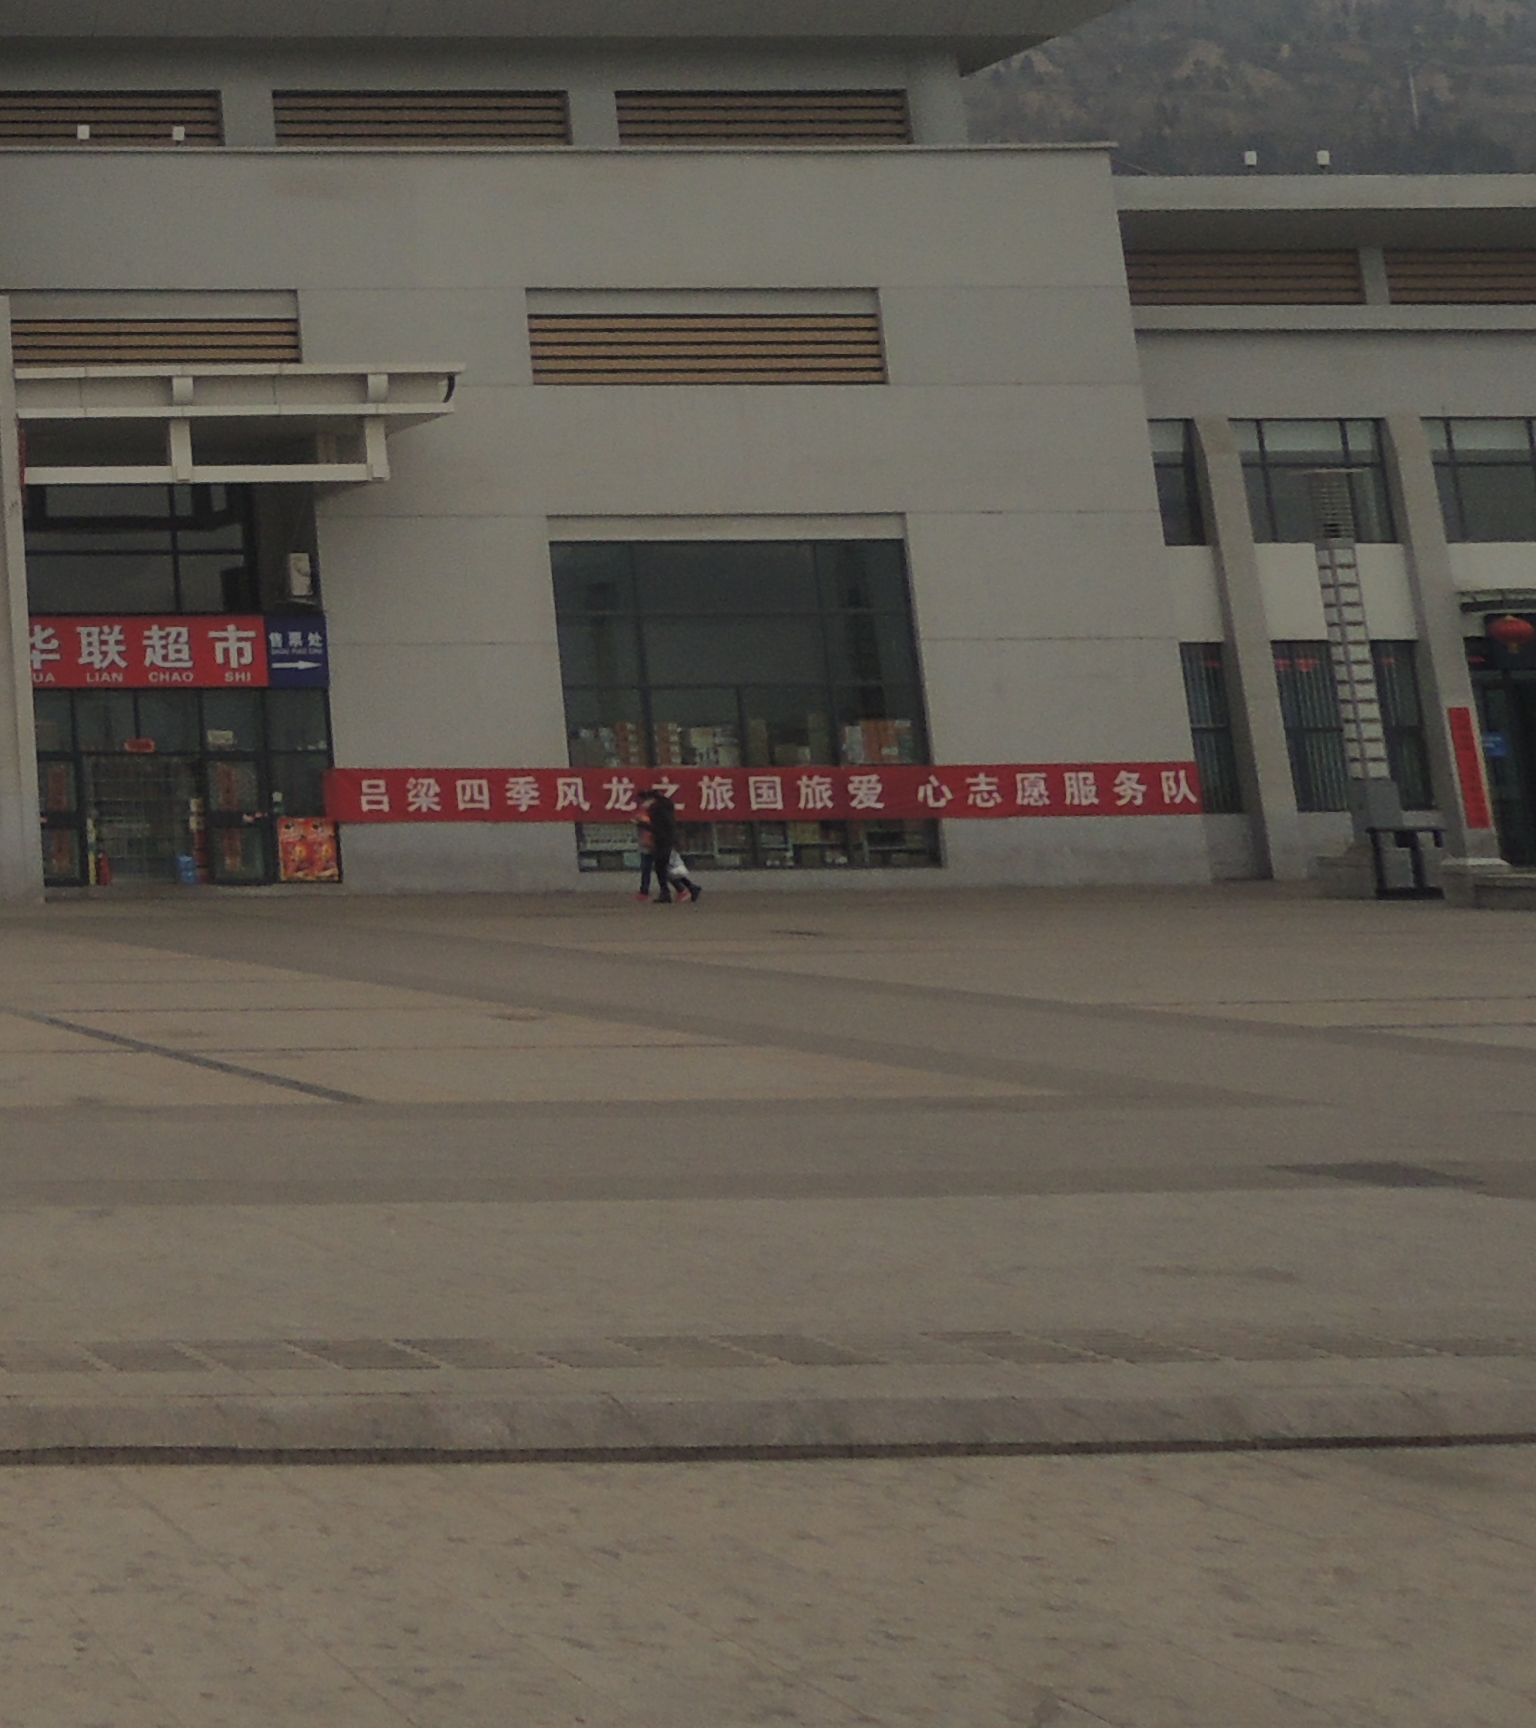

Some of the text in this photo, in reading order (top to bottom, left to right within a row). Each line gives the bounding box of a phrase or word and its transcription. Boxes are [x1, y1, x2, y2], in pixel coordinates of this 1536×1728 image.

[29, 624, 257, 670] 华联超市
[268, 631, 324, 648] 售票处
[86, 672, 123, 683] LIAN
[147, 671, 194, 683] CHAO
[224, 671, 252, 683] SHI
